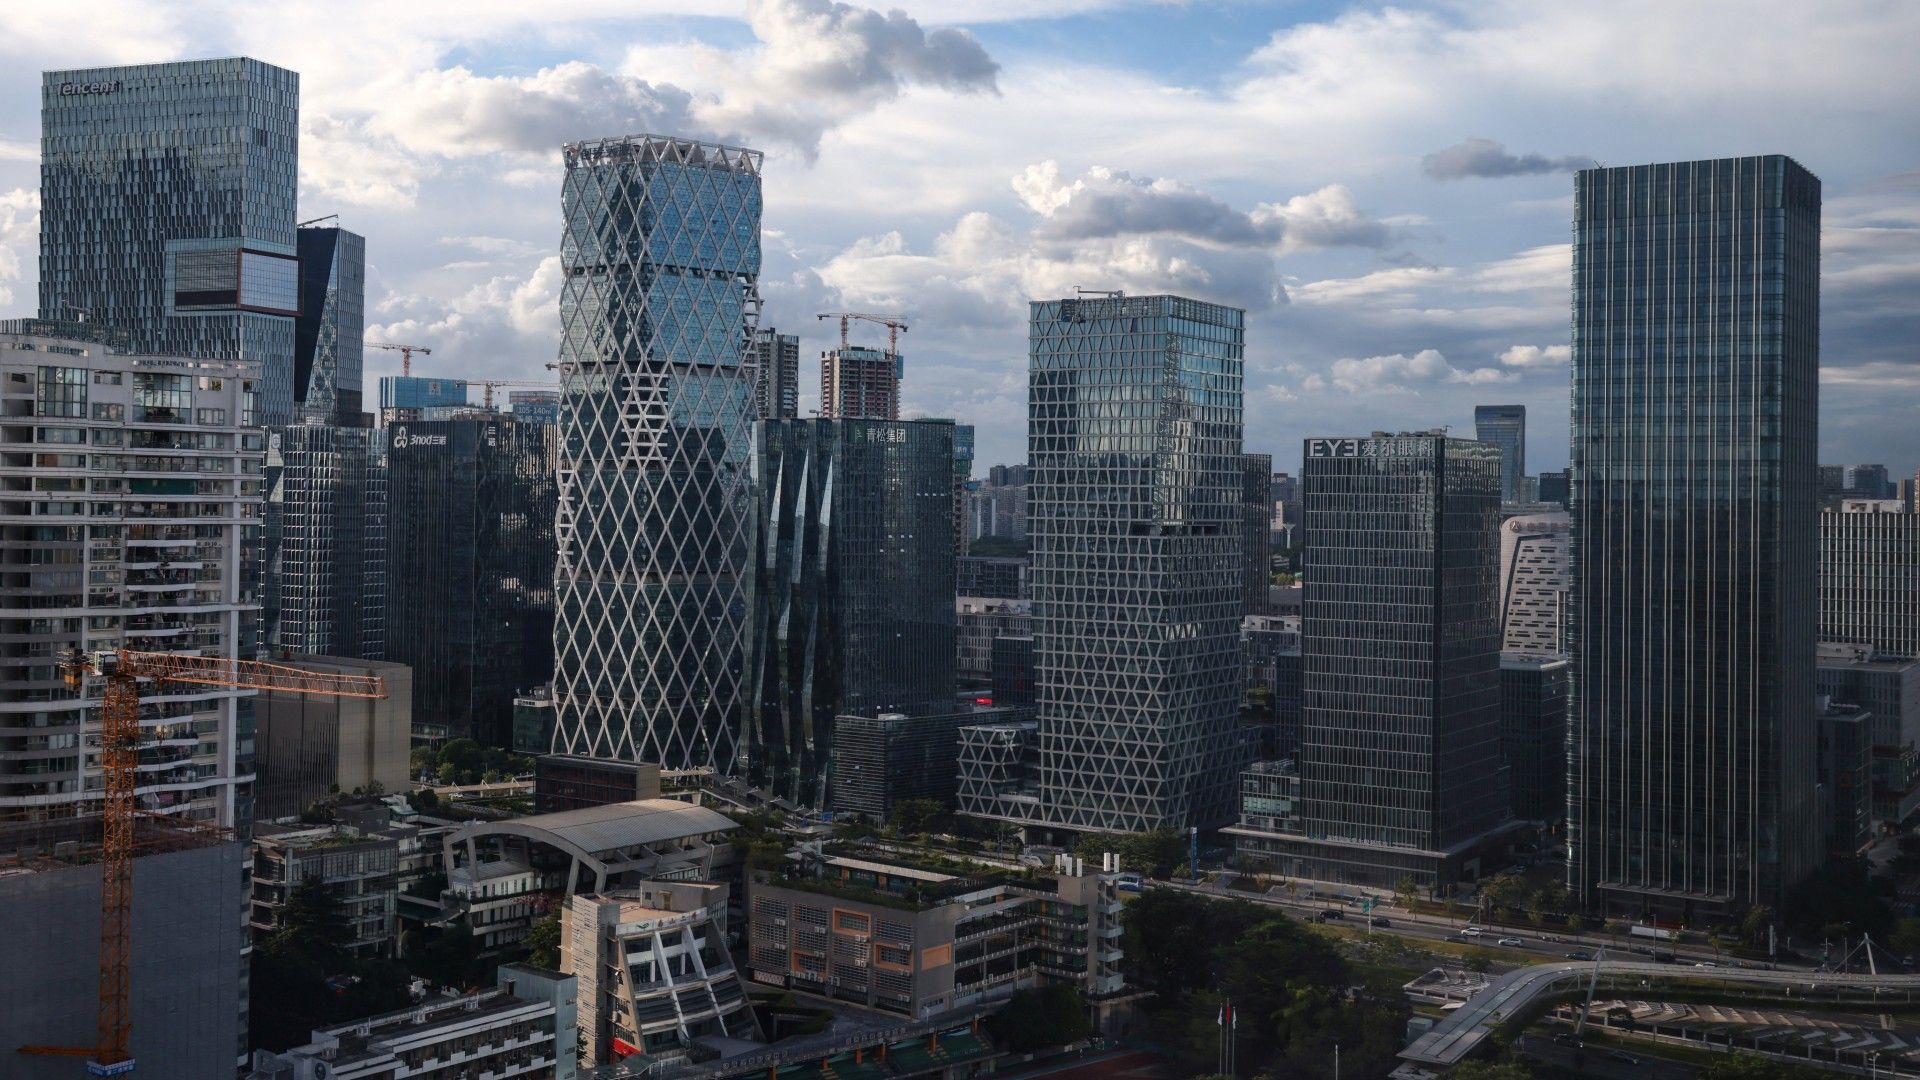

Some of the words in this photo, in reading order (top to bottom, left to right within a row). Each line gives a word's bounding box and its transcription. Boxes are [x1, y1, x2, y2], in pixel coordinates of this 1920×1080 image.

[56, 80, 118, 96] Tencent
[866, 428, 906, 443] 青松集团
